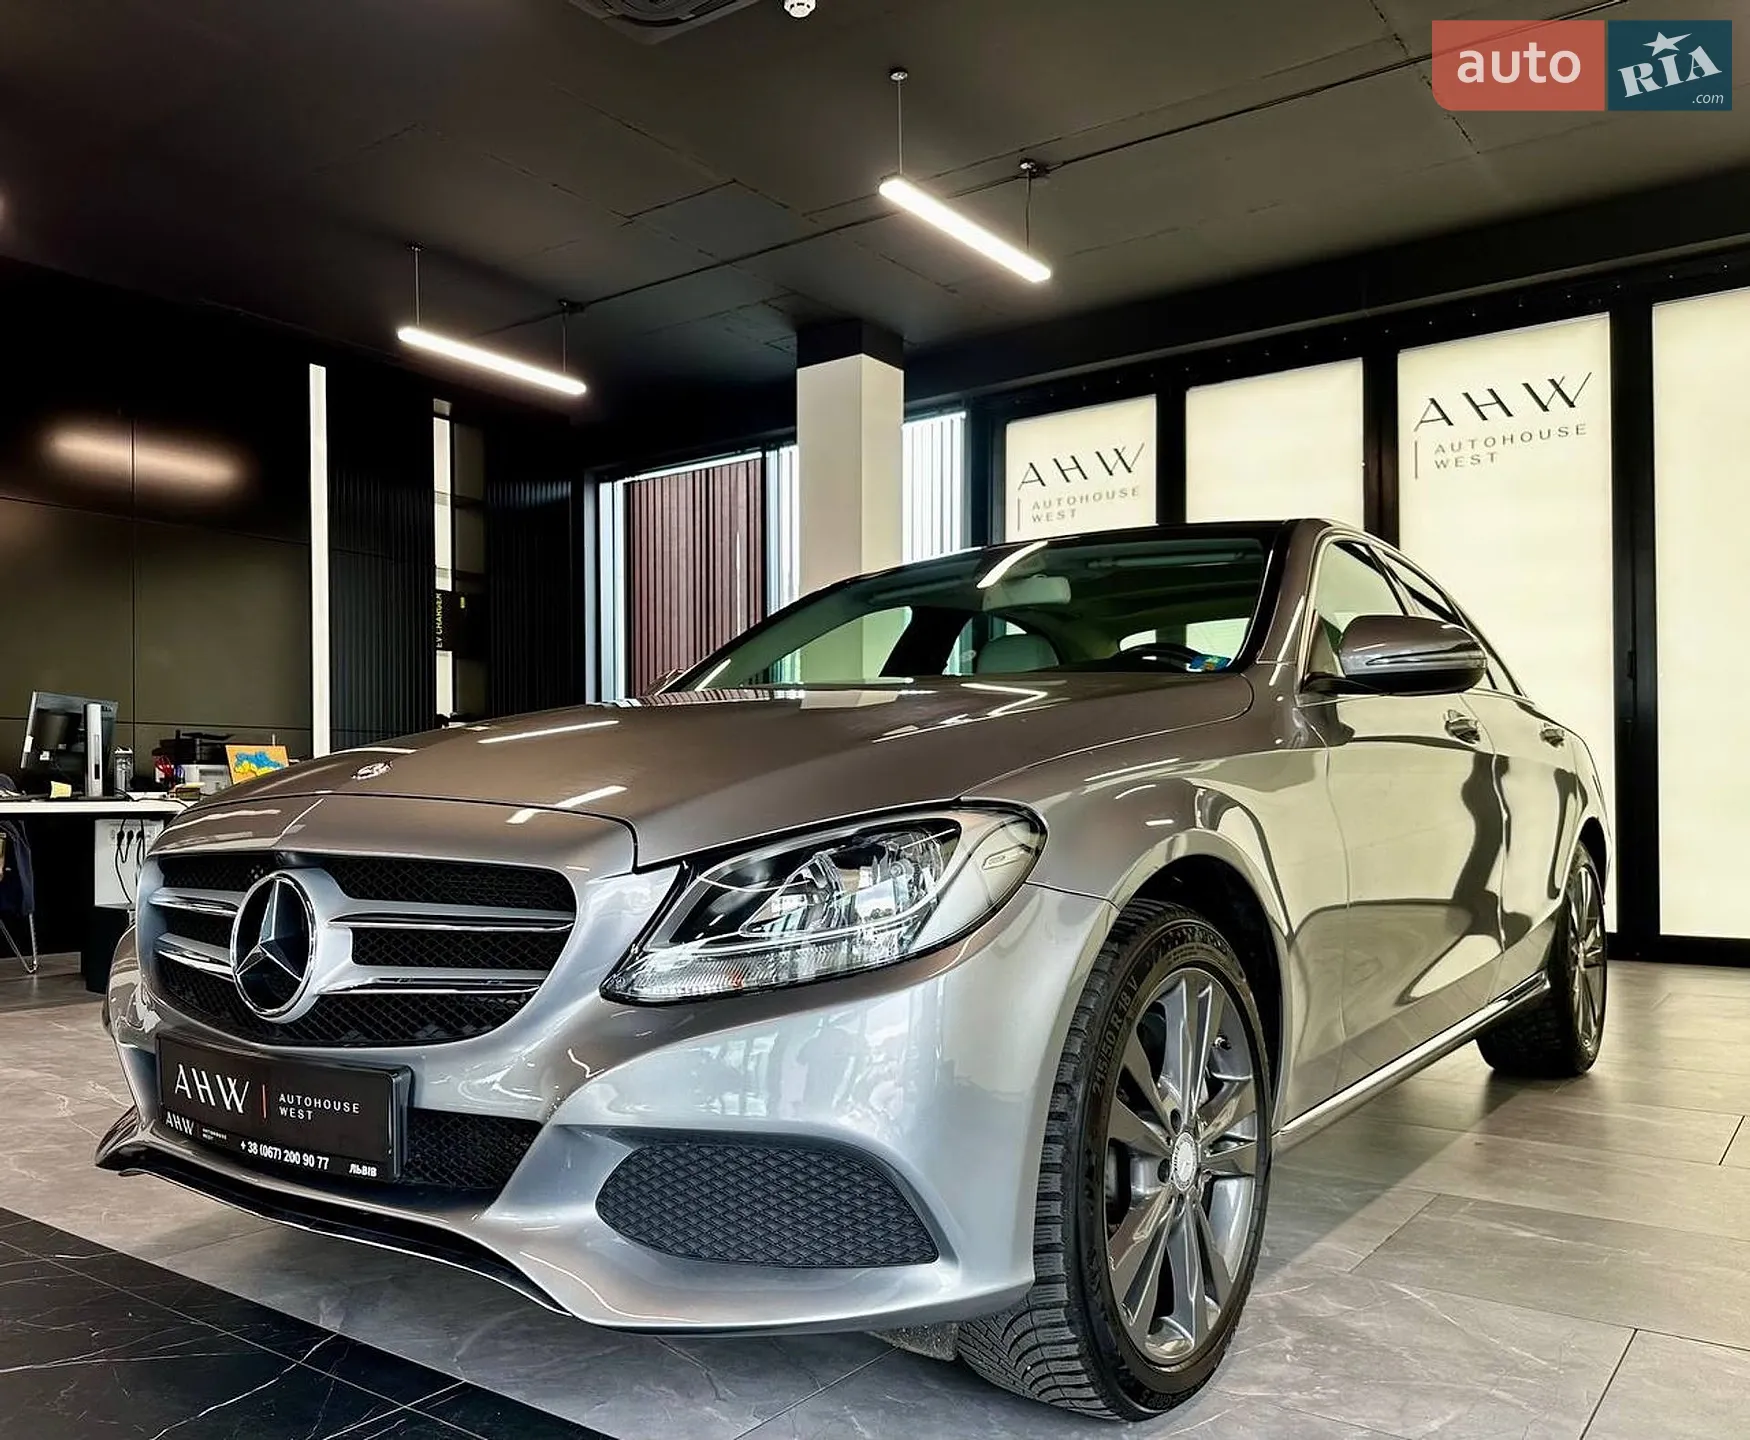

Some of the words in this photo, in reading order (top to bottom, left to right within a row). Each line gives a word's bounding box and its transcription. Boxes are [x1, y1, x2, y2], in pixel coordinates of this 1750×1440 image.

[1414, 372, 1592, 432] AHW
[1434, 423, 1588, 455] AUTOHOUSE
[1018, 442, 1145, 491] AHW
[1434, 451, 1498, 470] WEST
[1032, 485, 1140, 511] AUTOHOUSE
[1031, 508, 1077, 523] WEST
[174, 1063, 250, 1114] AHW
[279, 1093, 361, 1114] AUTOHOUSE
[279, 1106, 313, 1120] WEST
[165, 1111, 195, 1136] AHW
[247, 1141, 258, 1155] 38
[260, 1144, 281, 1160] (067)
[283, 1149, 300, 1165] 200
[302, 1153, 315, 1168] 90
[316, 1155, 330, 1170] 77
